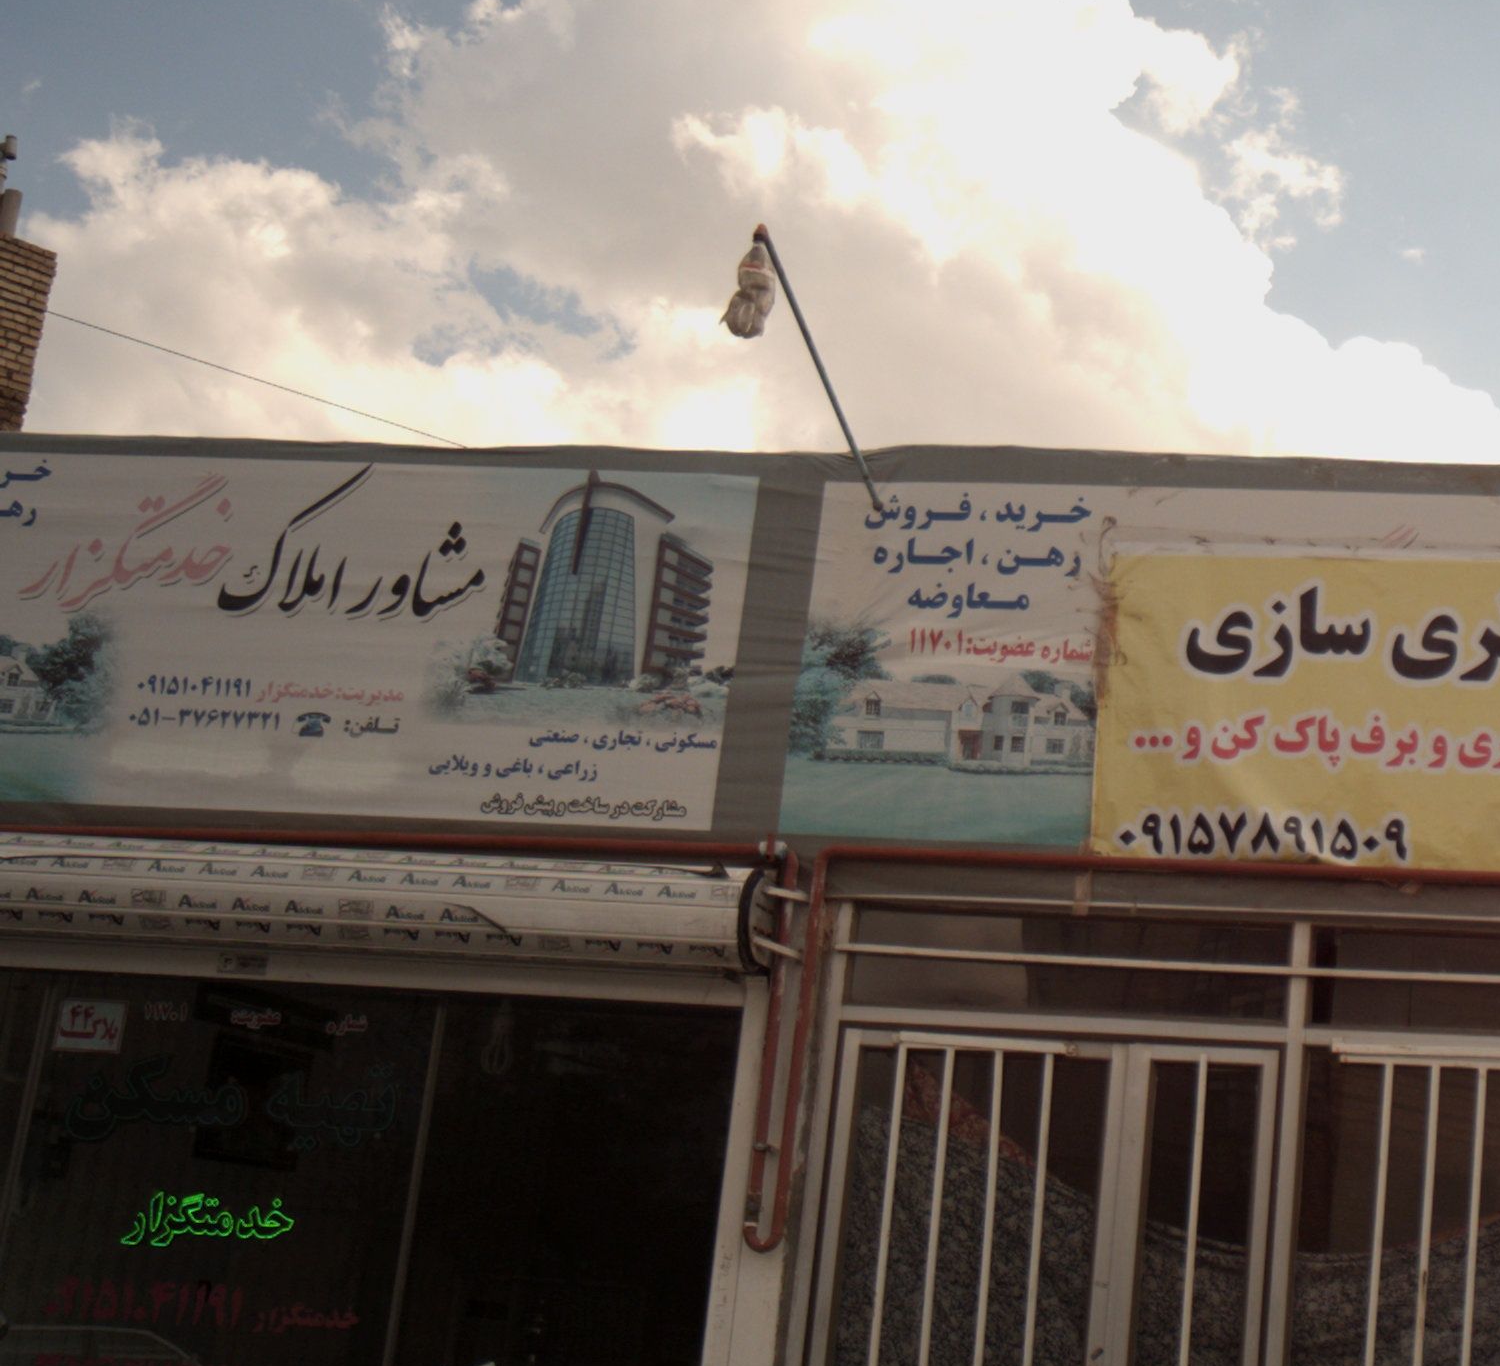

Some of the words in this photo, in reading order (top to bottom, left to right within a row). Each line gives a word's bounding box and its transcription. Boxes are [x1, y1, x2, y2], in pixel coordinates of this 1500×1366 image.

[864, 492, 972, 530] فروش
[17, 472, 233, 609] خدمتگزار
[217, 462, 375, 613] املاک
[344, 521, 486, 617] مشاور
[873, 537, 974, 574] اجاره
[907, 582, 1030, 618] معاوضه
[910, 628, 963, 655] ۱۱۷۰۱
[1186, 586, 1371, 678] سازی
[1041, 639, 1093, 663] شماره
[138, 674, 252, 697] ۰۹۱۵۱۰۴۱۱۹۱
[529, 729, 579, 747] صنعتی
[1182, 726, 1202, 759] و
[1211, 716, 1265, 760] کن
[1275, 716, 1341, 768] پاک
[1350, 715, 1418, 767] برف
[1428, 735, 1448, 768] و
[429, 754, 478, 777] ویلایی
[482, 764, 491, 777] و
[496, 758, 533, 779] باغی
[480, 792, 523, 814] فروش
[567, 796, 609, 815] ساخت
[609, 801, 630, 819] در
[631, 799, 687, 821] مشارکت
[1120, 811, 1407, 861] ۰۹۱۵۷۸۹۱۵۰۹
[66, 1053, 246, 1140] مسکن
[119, 1189, 297, 1249] خدمتگزار
